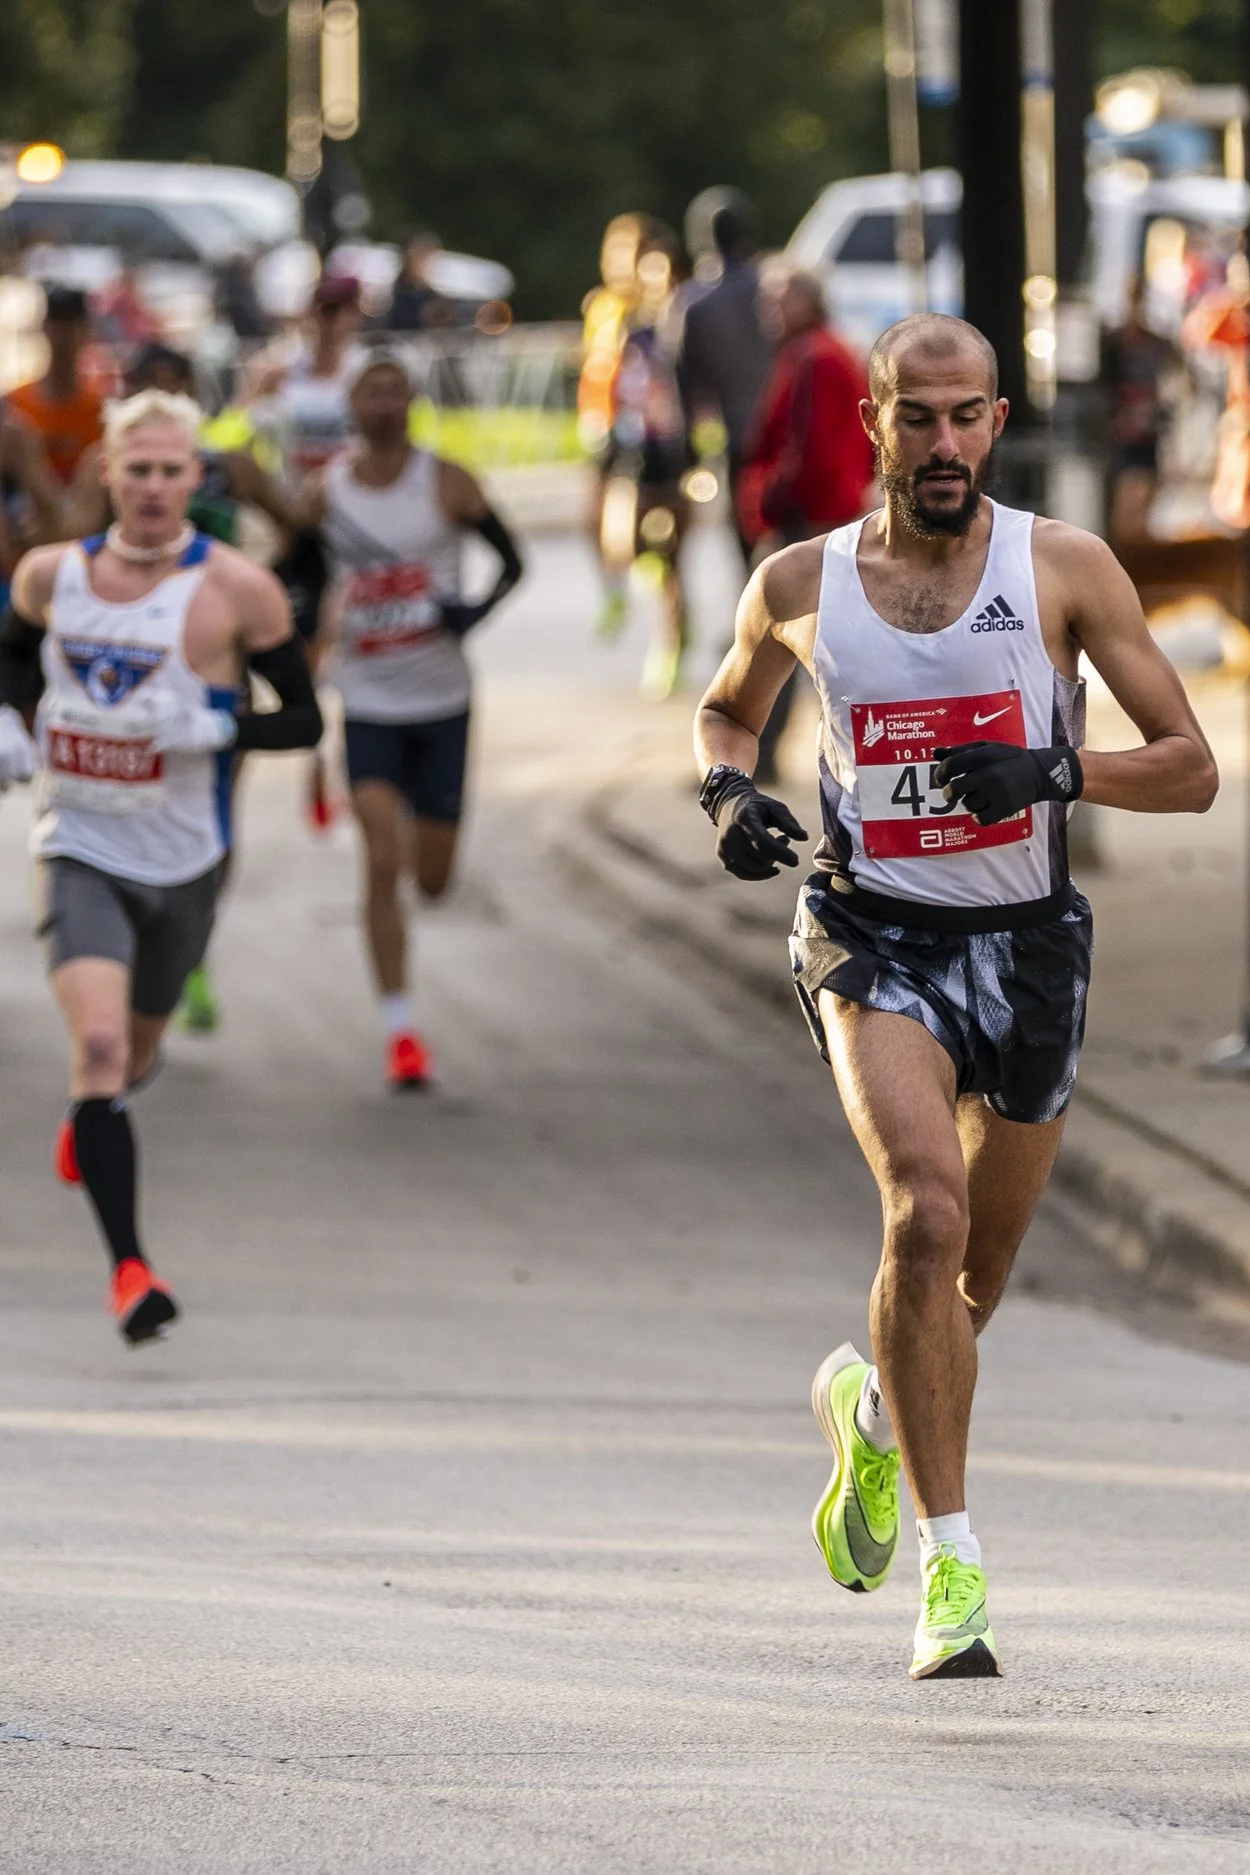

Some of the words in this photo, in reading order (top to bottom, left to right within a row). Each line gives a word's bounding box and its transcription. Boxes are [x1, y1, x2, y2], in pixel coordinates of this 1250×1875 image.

[970, 617, 1025, 633] adidas
[886, 719, 925, 733] Chicago
[887, 729, 935, 741] Marathon
[1061, 757, 1072, 793] adidas
[945, 834, 977, 842] MARATHON
[945, 839, 968, 847] MAJORS
